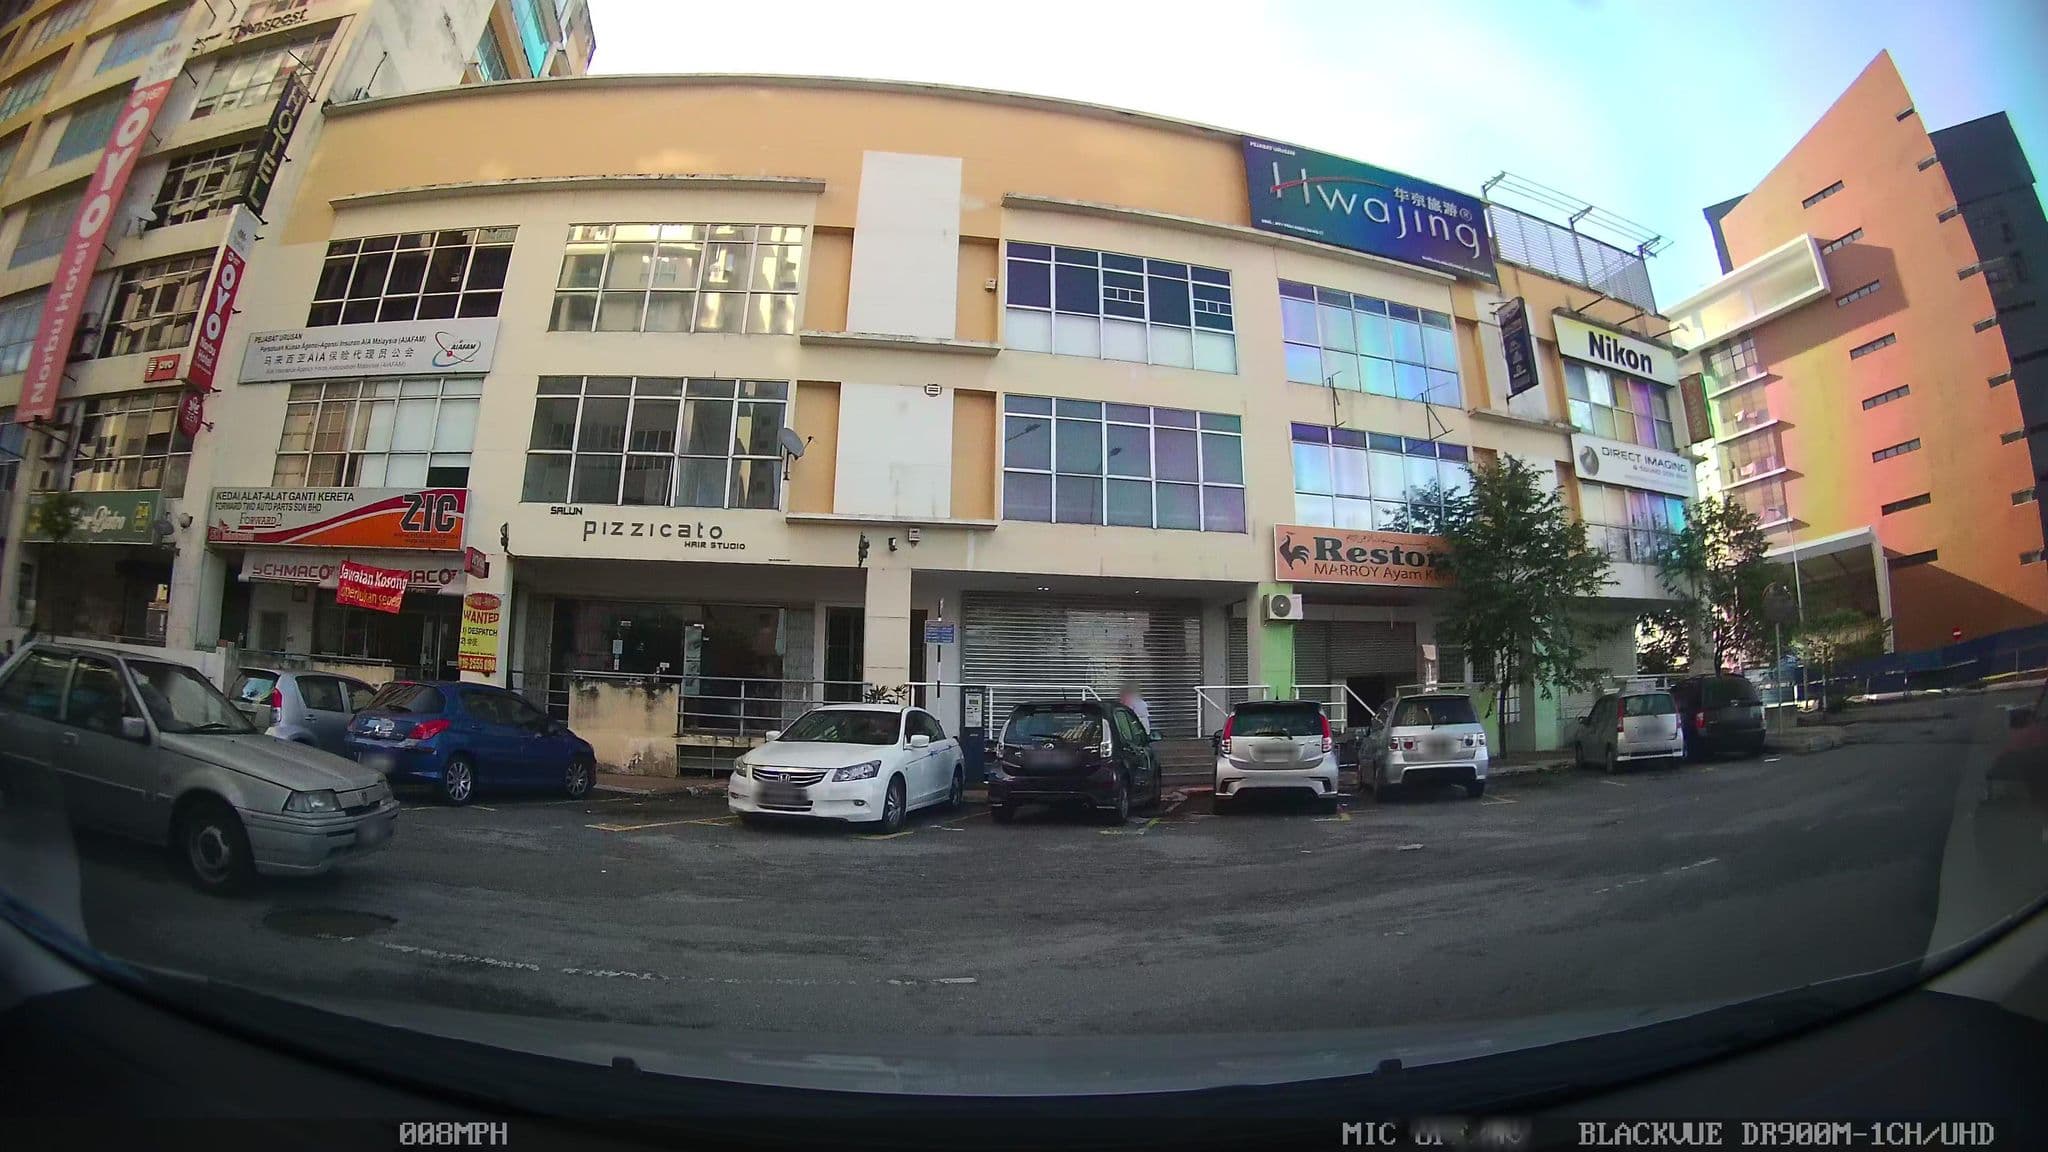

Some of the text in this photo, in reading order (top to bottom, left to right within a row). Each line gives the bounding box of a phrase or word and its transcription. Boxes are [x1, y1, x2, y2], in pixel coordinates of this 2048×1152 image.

[249, 84, 303, 208] HOTEL
[78, 106, 150, 239] OYO
[1270, 161, 1481, 260] Hwajing
[206, 264, 236, 341] OYO
[1588, 331, 1653, 374] Nikon
[1601, 447, 1688, 473] DIRECT IMAGING
[215, 502, 322, 512] FORWARD TWO AUTO PARTS SDN BHD
[216, 491, 355, 502] KEDAI ALAT-ALAT GANTI KERETA
[400, 493, 459, 533] ZIC
[550, 506, 583, 516] SALUN
[684, 541, 746, 550] HAIR STUDIO
[252, 564, 331, 580] SCHMACO
[340, 563, 408, 595] Jawatan Kosong
[1313, 562, 1382, 576] MARROY
[1383, 567, 1422, 582] Ayam
[464, 609, 500, 624] WANTED
[467, 626, 498, 637] DESPATCH
